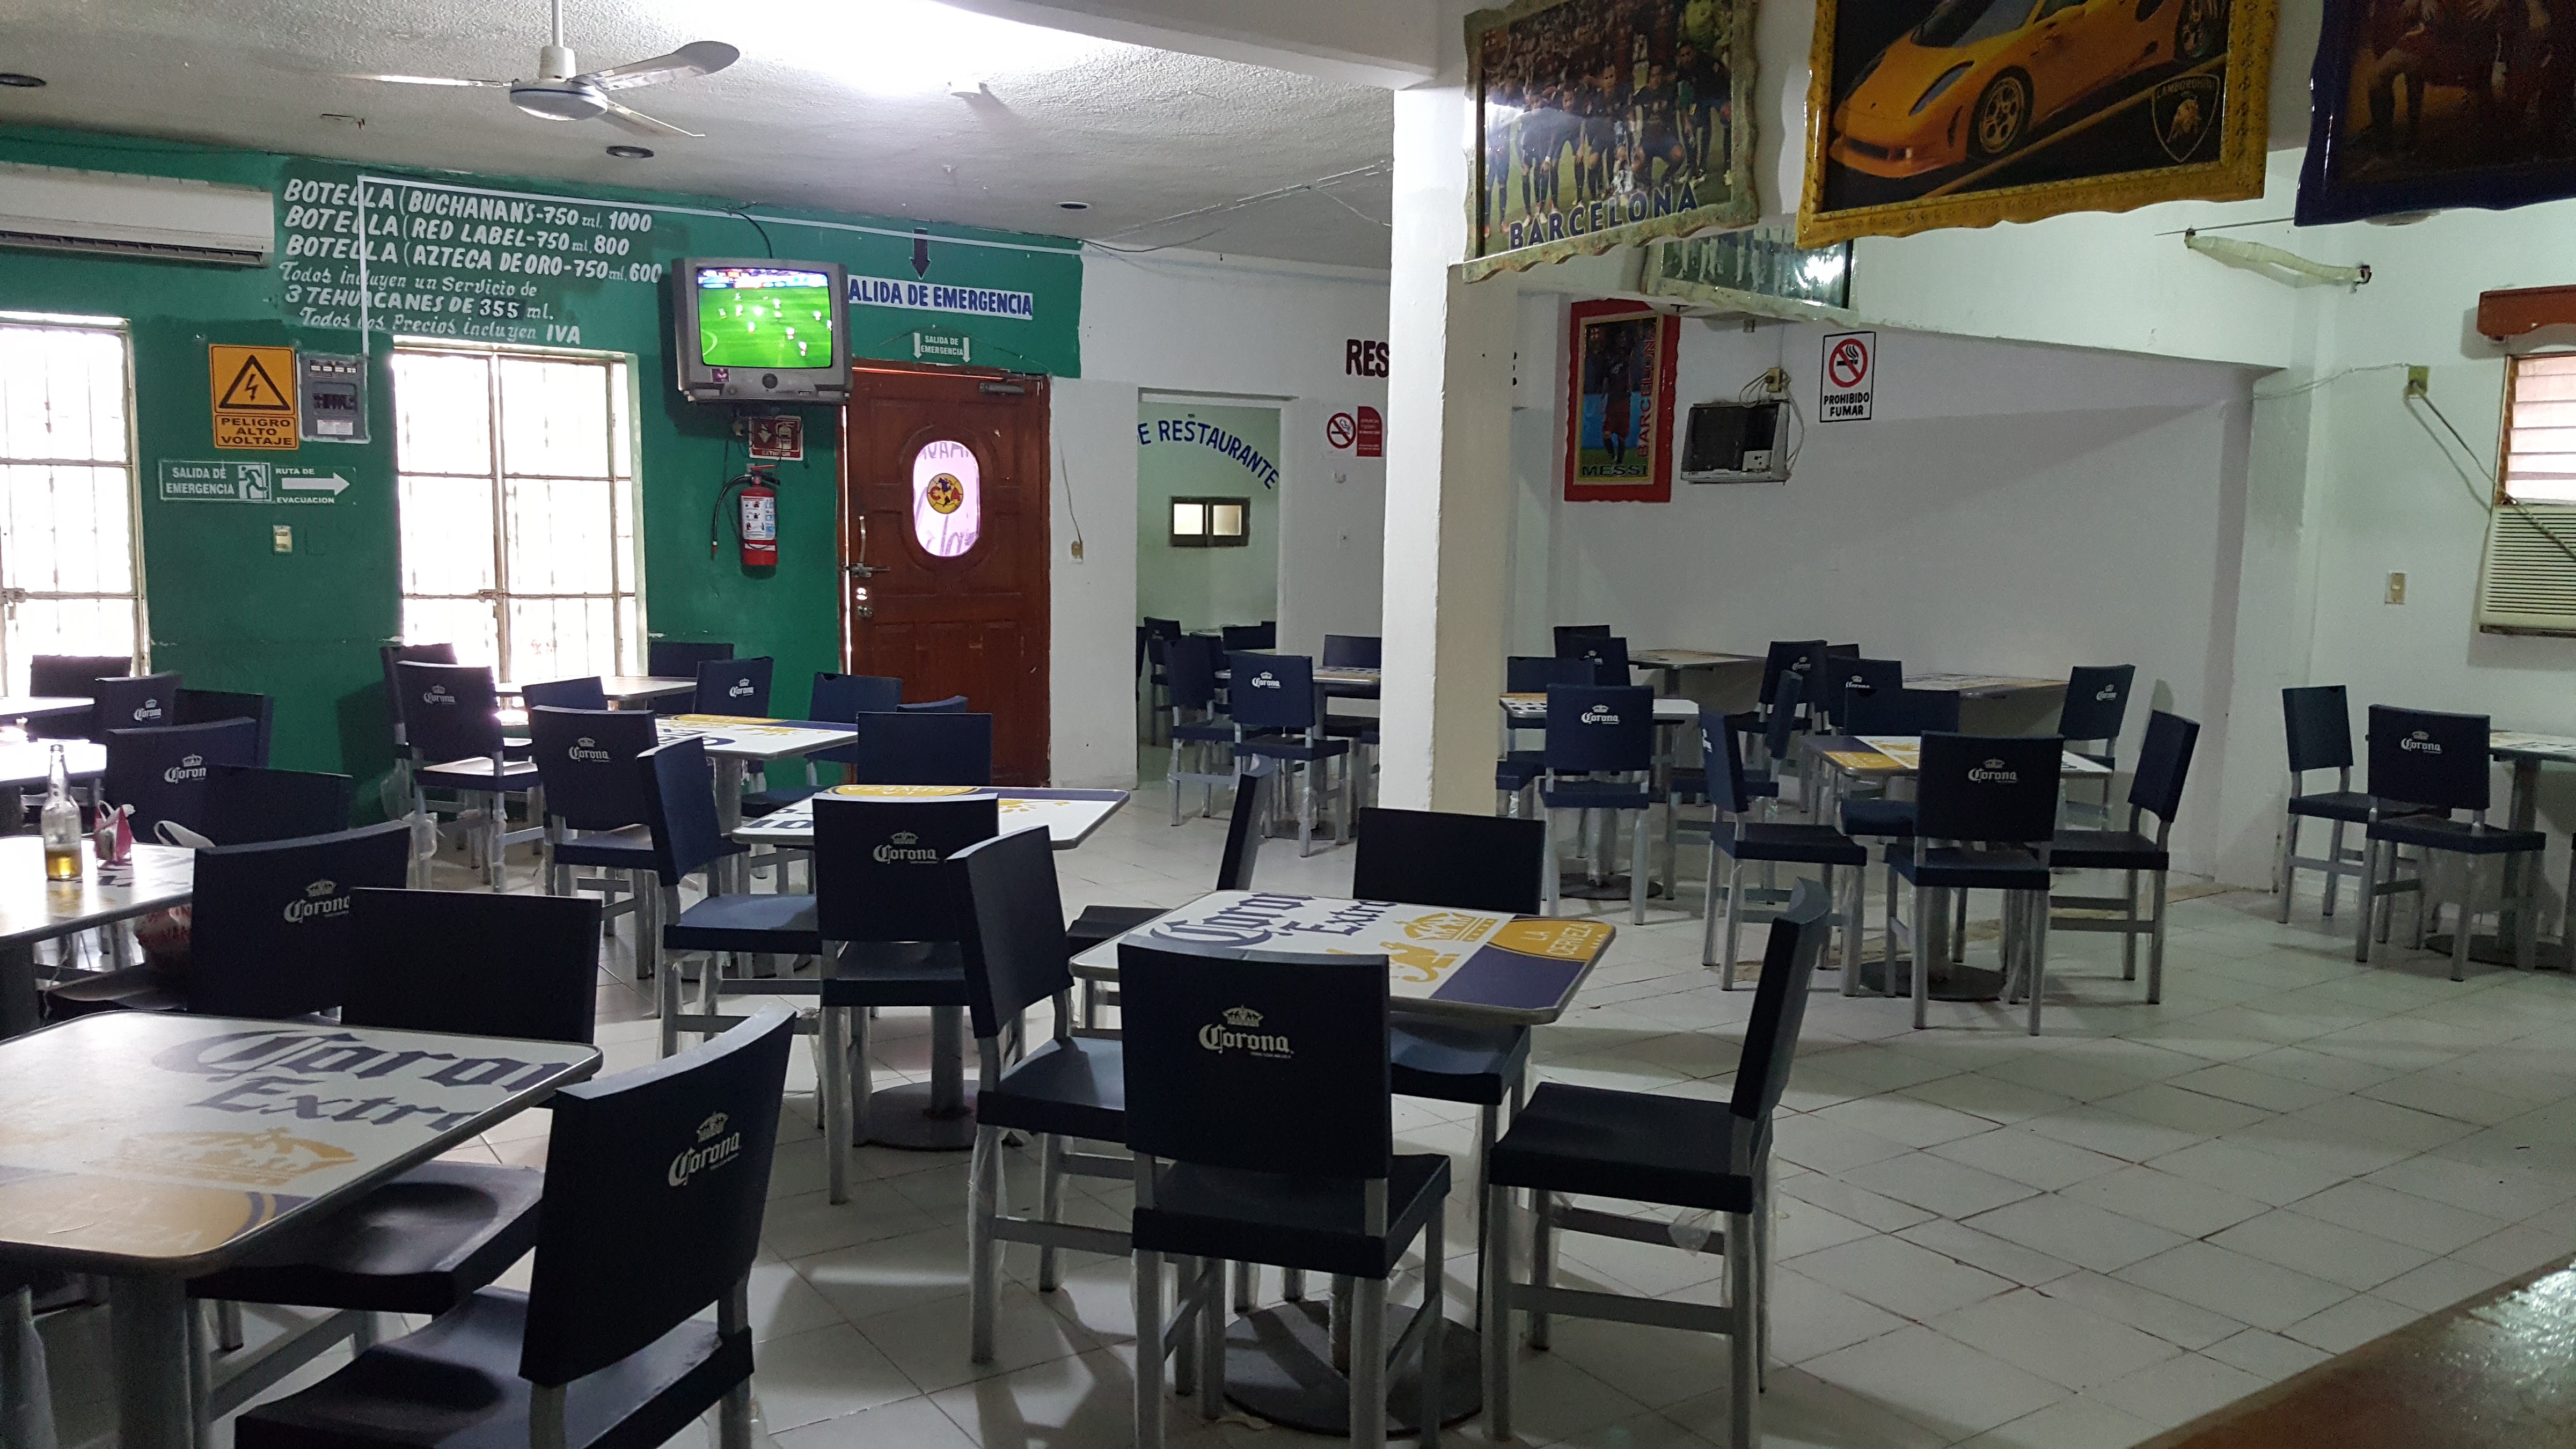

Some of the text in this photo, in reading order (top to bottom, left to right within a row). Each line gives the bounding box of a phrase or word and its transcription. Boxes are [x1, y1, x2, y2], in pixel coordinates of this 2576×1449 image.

[284, 178, 394, 210] BOTELLA
[609, 210, 652, 232] 1000
[1509, 181, 1699, 251] BARCELONA
[284, 205, 399, 237] BOTELLA
[594, 234, 630, 256] 800
[286, 234, 398, 264] BOTELLA
[499, 252, 520, 273] DE
[629, 262, 663, 283] 600
[279, 261, 332, 284] Todos
[415, 277, 437, 290] un
[442, 276, 515, 296] Servicio
[520, 280, 538, 297] de
[285, 284, 303, 303] 3
[448, 296, 475, 314] DE
[479, 298, 521, 319] 355
[849, 278, 1033, 317] ALIDA DE EMERGENCIA
[299, 306, 351, 328] Todos
[392, 313, 457, 334] Precios
[463, 317, 537, 342] incluyen
[546, 324, 581, 345] IVA
[925, 335, 959, 346] SALIDA DE
[920, 345, 964, 356] EMERGENCIA
[1638, 326, 1656, 458] BARCELONA
[1824, 392, 1870, 406] PROHIBIDO
[1829, 405, 1863, 417] FUMAR
[221, 418, 291, 428] PELIGRO
[236, 427, 277, 436] ALTO
[221, 436, 294, 446] VOLTAJE
[1137, 420, 1279, 489] E RESTAURANTE
[172, 466, 227, 479] SALIDA DE
[1582, 465, 1648, 477] MESSI
[165, 482, 235, 495] EMERGENCIA
[1252, 677, 1280, 688] Corona
[729, 686, 754, 698] Corona
[1580, 712, 1620, 724] Corona
[2401, 737, 2442, 752] Corona
[569, 746, 611, 762] Corona
[164, 766, 207, 784] Coron
[1967, 767, 2017, 783] Corona
[873, 844, 939, 865] Corona
[1519, 930, 1552, 941] LA
[1546, 923, 1596, 956] CERVEZA
[1198, 1023, 1291, 1055] Corona
[668, 1131, 741, 1187] Corona
